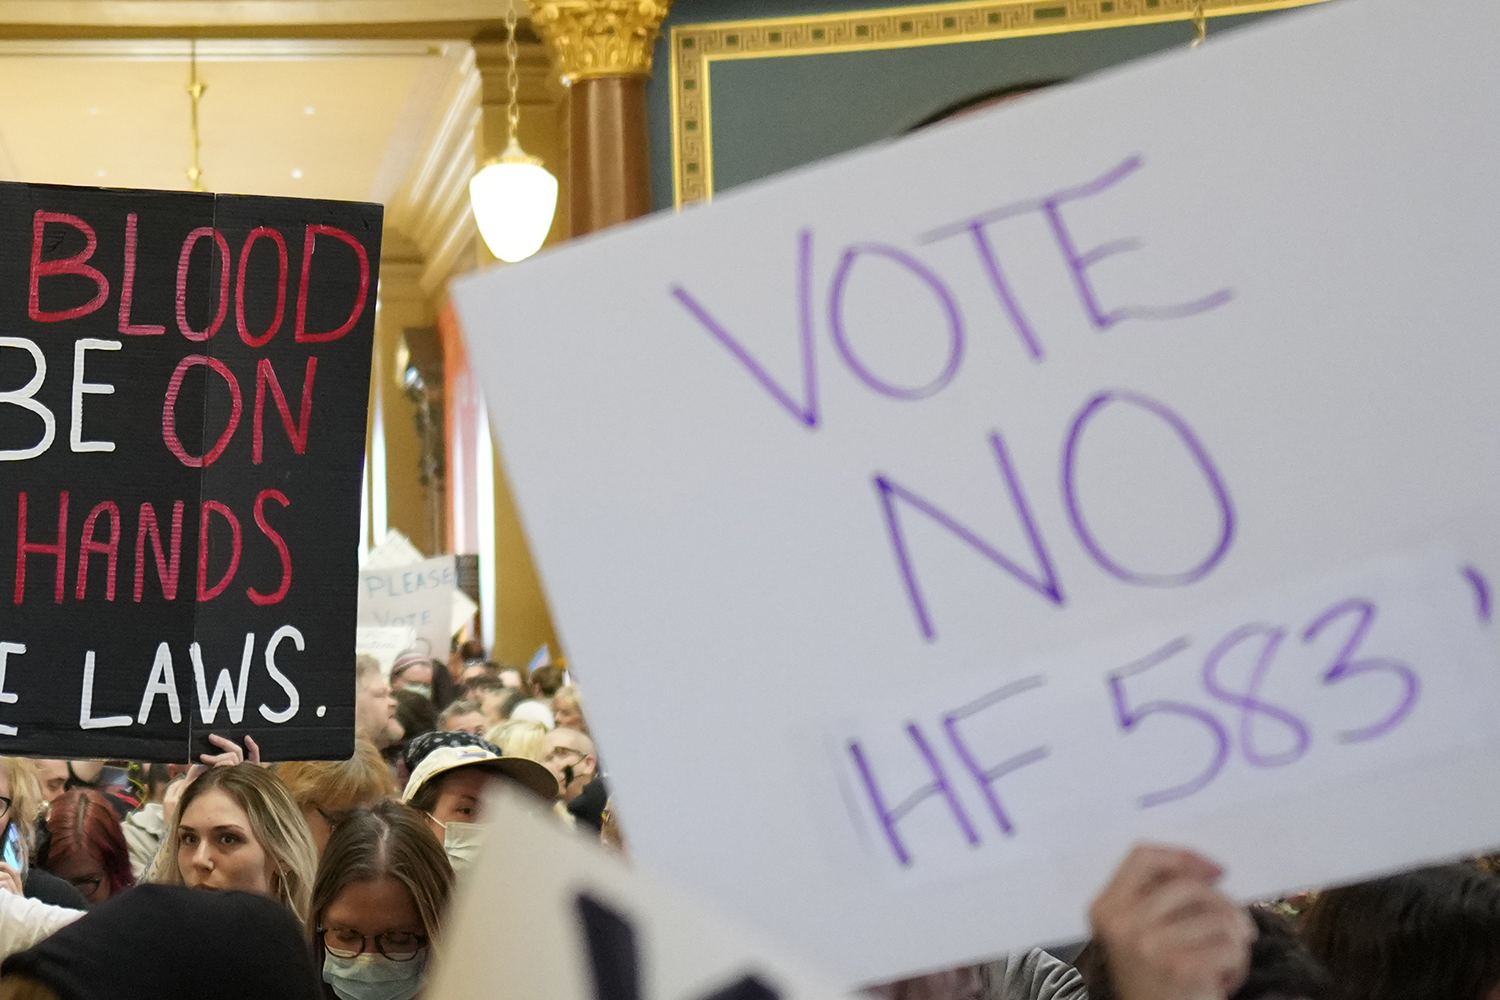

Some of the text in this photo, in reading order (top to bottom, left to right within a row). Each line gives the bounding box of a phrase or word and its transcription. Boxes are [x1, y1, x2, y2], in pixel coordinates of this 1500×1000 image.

[27, 208, 371, 347] BLOOD
[670, 154, 1236, 431] VOTE
[161, 354, 318, 468] ON
[13, 488, 295, 606] HANDS
[871, 389, 1240, 644] NO
[364, 567, 452, 598] PLEASE
[79, 624, 329, 730] LAWS.
[846, 596, 1422, 869] HF 583
